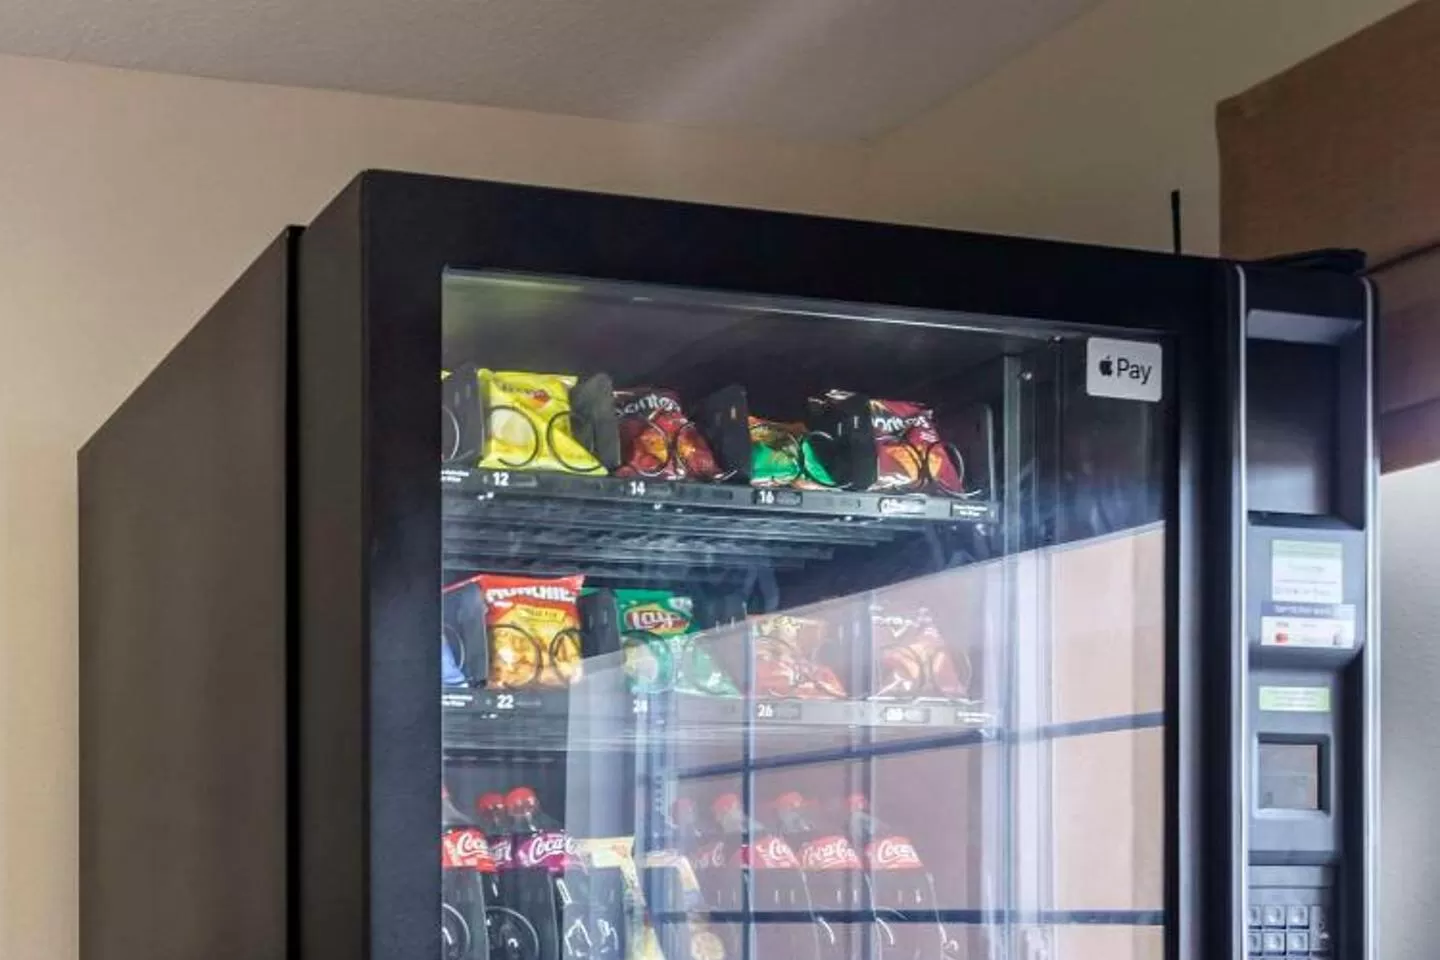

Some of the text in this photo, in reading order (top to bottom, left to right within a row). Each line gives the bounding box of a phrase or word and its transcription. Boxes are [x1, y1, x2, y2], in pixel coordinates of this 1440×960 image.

[1117, 357, 1152, 385] Pay
[493, 472, 509, 486] 12
[630, 481, 645, 495] 14
[759, 491, 774, 504] 16
[497, 695, 514, 708] 22
[758, 705, 773, 717] 26
